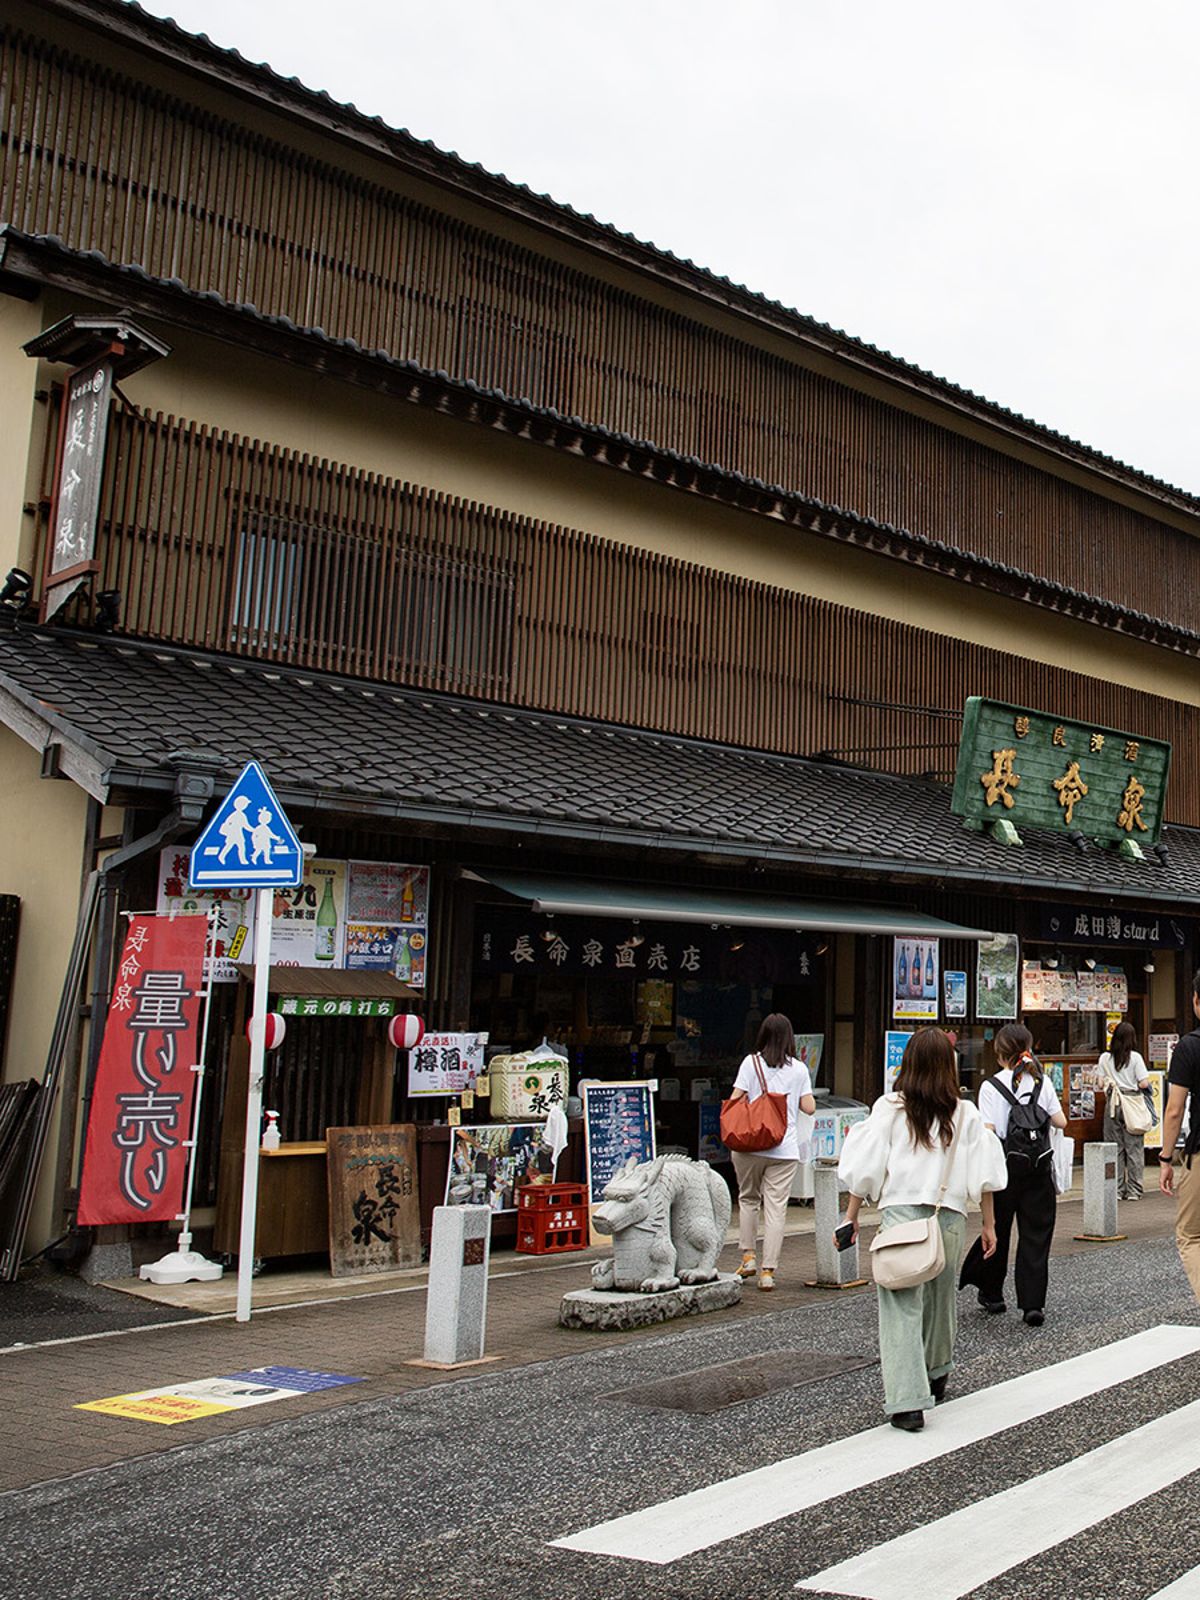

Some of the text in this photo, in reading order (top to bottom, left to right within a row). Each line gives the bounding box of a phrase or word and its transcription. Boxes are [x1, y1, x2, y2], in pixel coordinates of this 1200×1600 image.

[980, 748, 1148, 833] 長命泉
[510, 935, 701, 972] 長命泉直売店
[414, 1047, 461, 1073] 樽酒
[528, 1072, 564, 1114] 長命泉
[351, 1165, 401, 1246] 長命泉
